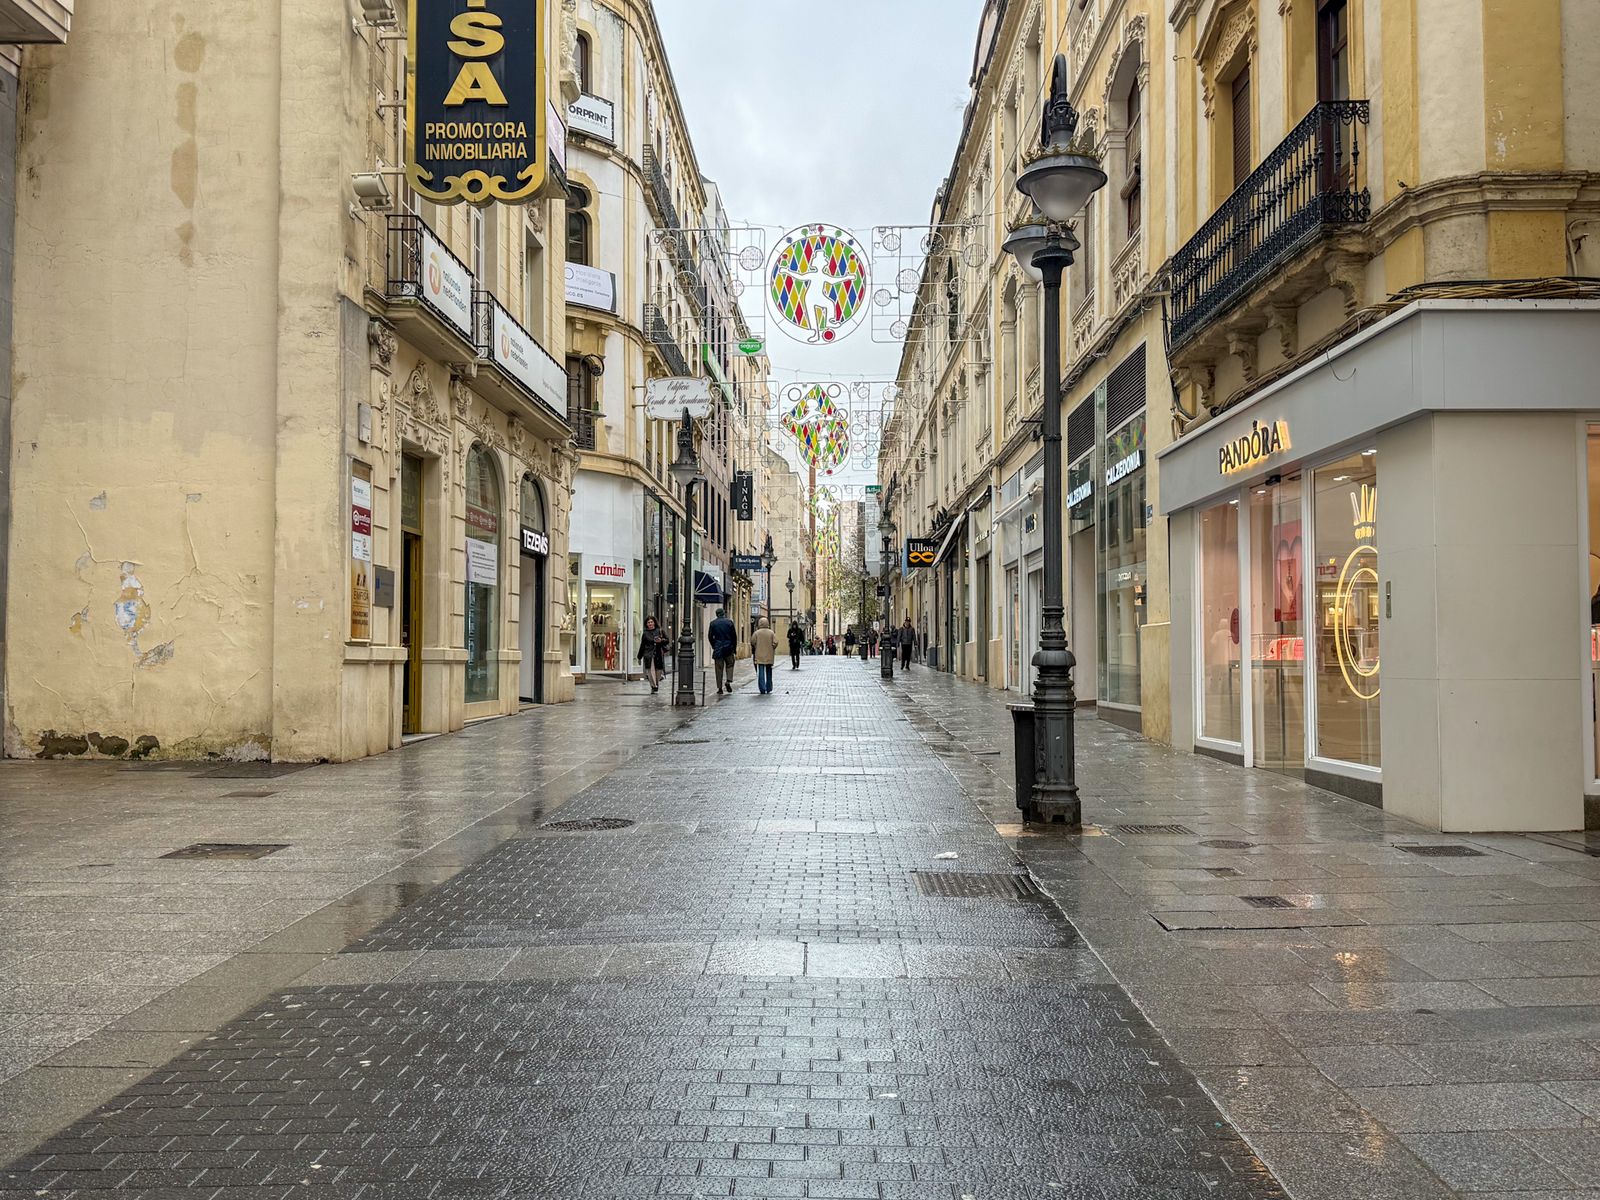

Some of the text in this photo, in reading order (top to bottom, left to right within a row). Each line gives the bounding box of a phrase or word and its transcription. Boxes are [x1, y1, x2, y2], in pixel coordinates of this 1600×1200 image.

[442, 0, 509, 106] SA
[425, 122, 527, 139] PROMOTORA
[425, 142, 528, 160] INMOBILIARIA
[668, 395, 677, 405] de
[1106, 449, 1141, 486] CALZEDONIA
[909, 542, 934, 552] Ulloa
